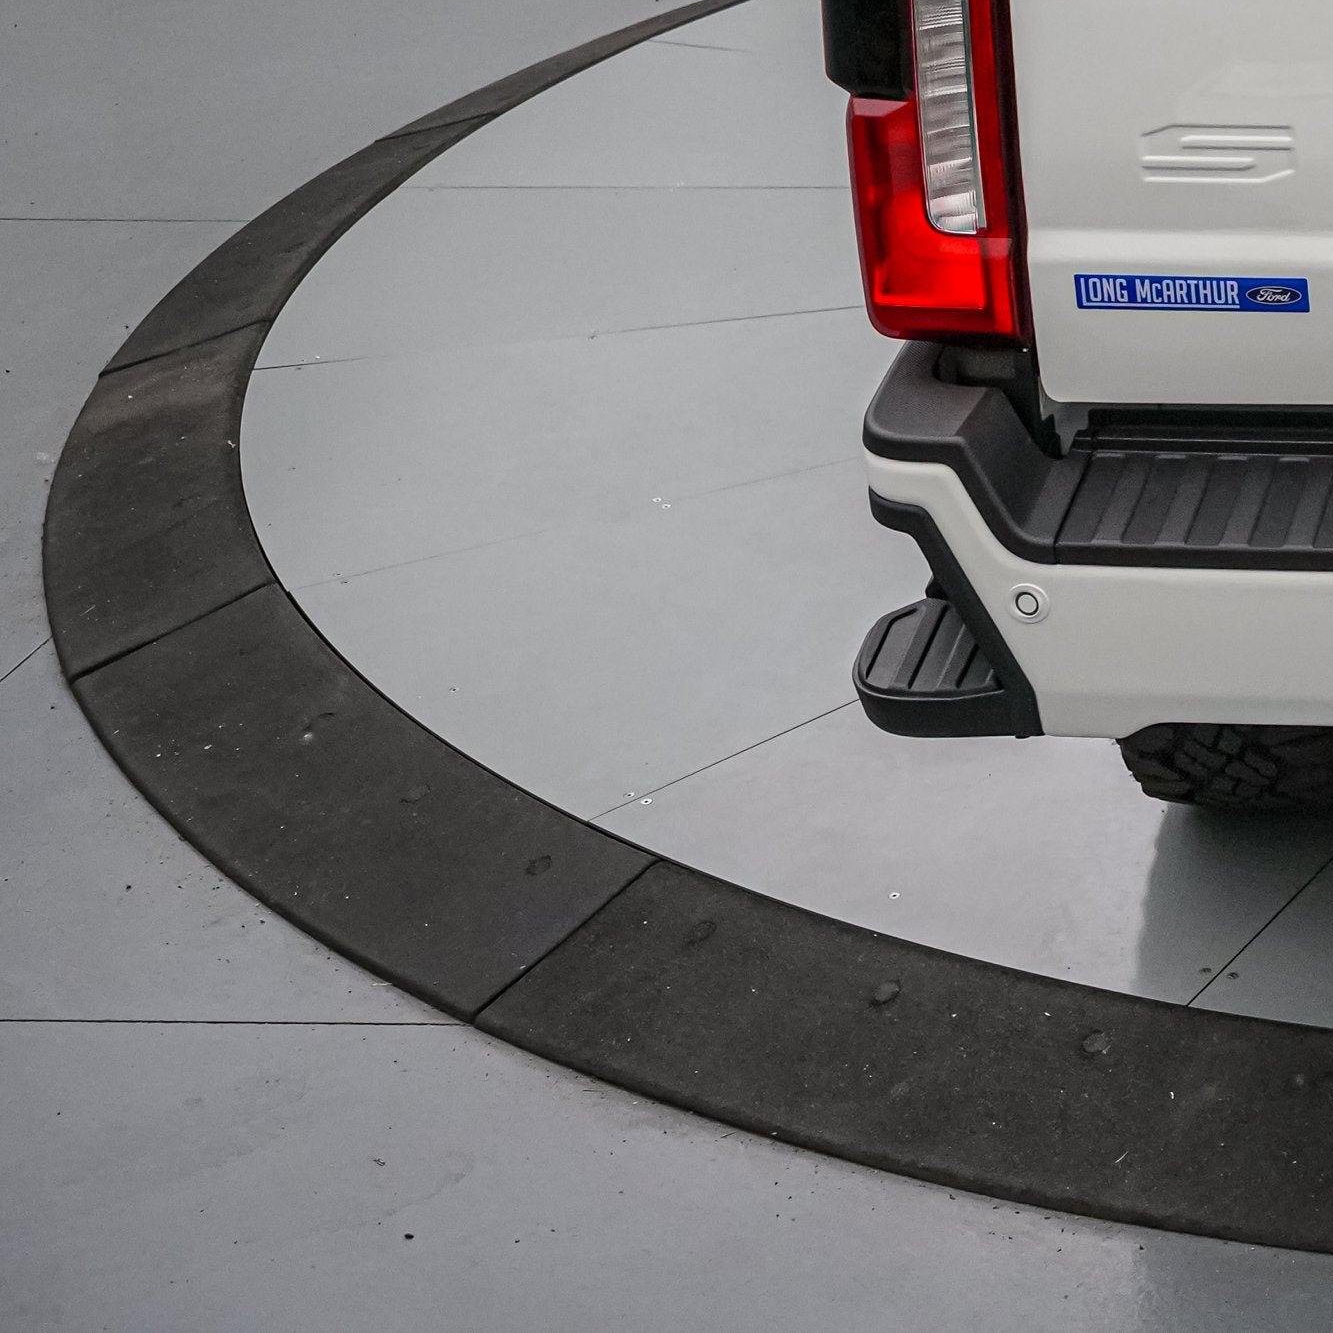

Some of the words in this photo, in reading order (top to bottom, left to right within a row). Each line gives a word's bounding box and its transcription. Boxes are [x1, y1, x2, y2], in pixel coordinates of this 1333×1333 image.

[1080, 278, 1129, 306] LONG
[1135, 279, 1240, 305] McARTHUR
[1256, 289, 1291, 303] Ford
